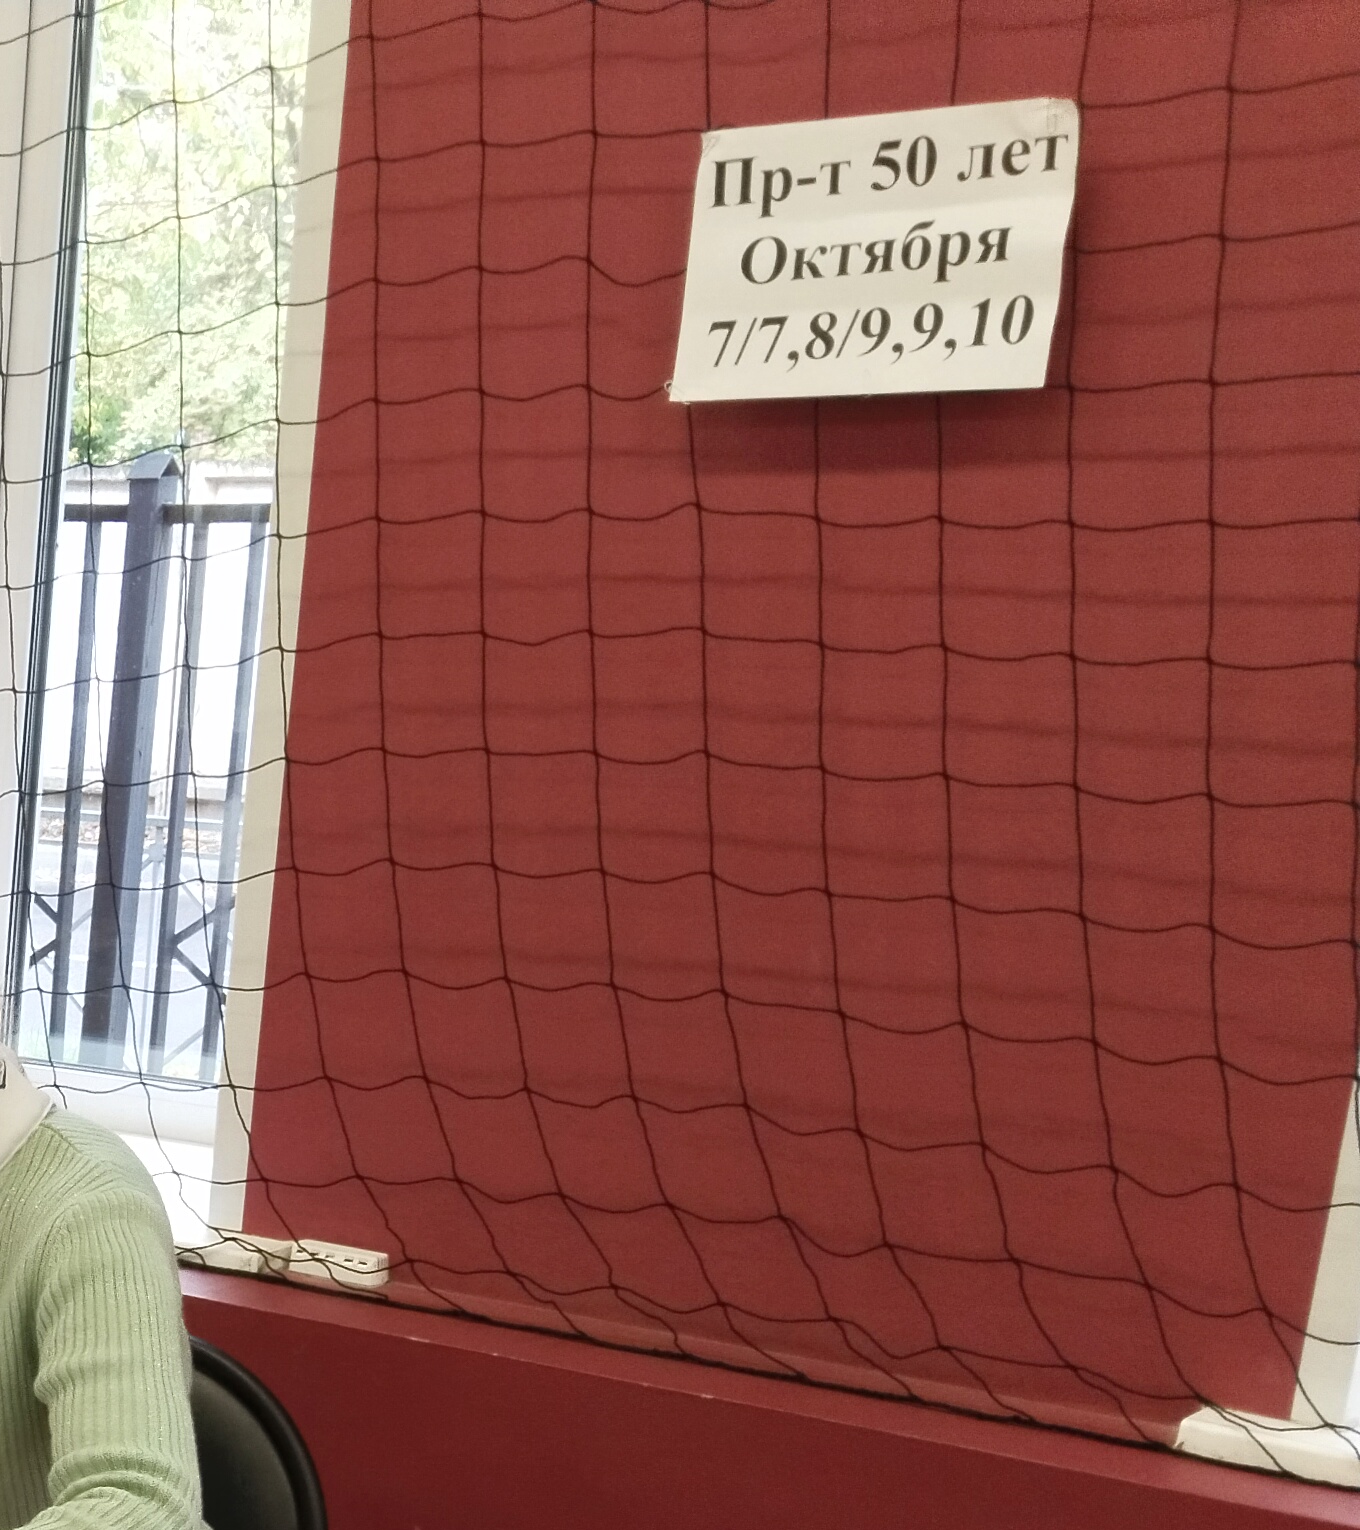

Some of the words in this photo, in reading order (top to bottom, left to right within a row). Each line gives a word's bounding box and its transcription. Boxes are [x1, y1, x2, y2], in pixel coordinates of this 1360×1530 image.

[711, 156, 852, 218] Пр-т
[870, 135, 938, 191] 50
[957, 132, 1070, 181] лет
[740, 220, 1011, 285] Октября
[707, 294, 1035, 371] 7/7,8/9,9,10
